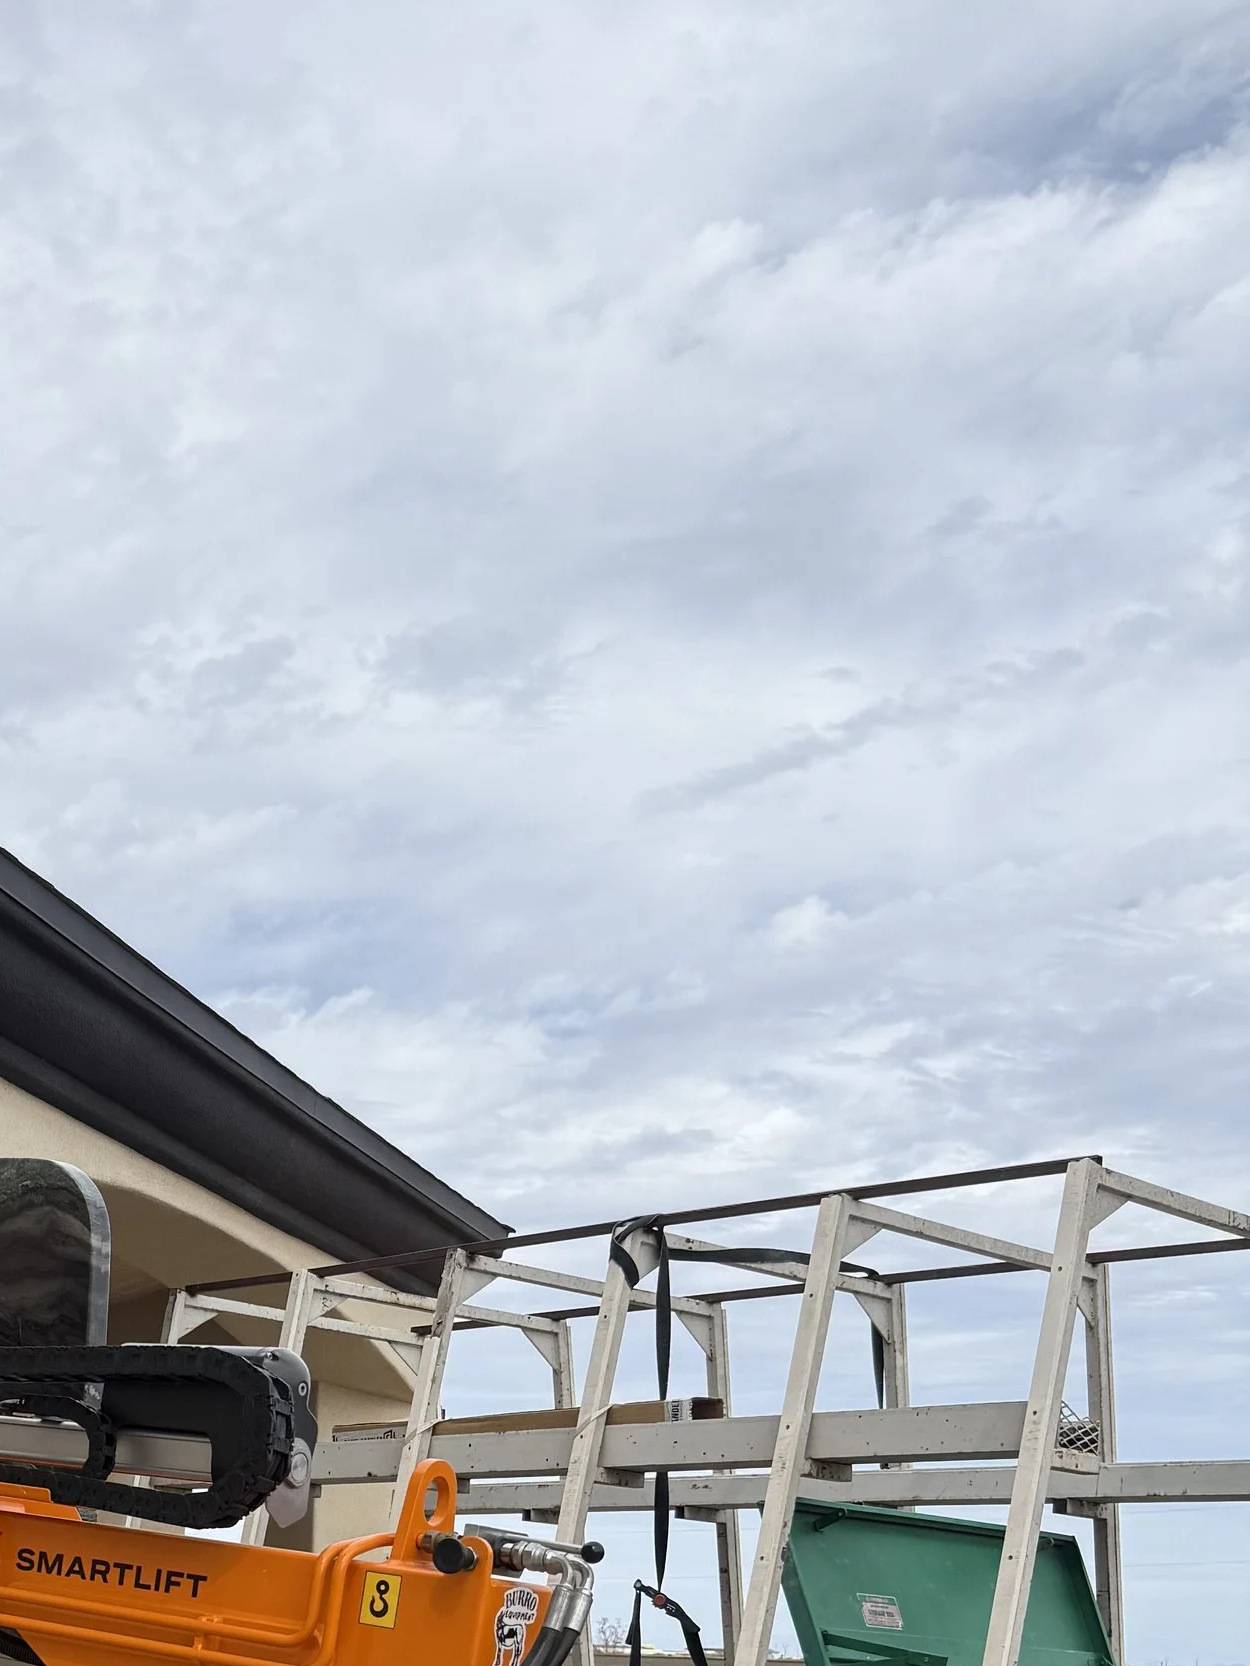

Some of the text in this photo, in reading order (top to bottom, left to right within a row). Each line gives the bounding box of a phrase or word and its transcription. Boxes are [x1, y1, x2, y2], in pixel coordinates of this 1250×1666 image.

[16, 1548, 207, 1598] SMARTLIFT
[506, 1589, 537, 1612] BURRO
[505, 1609, 535, 1622] EQUIPMENT
